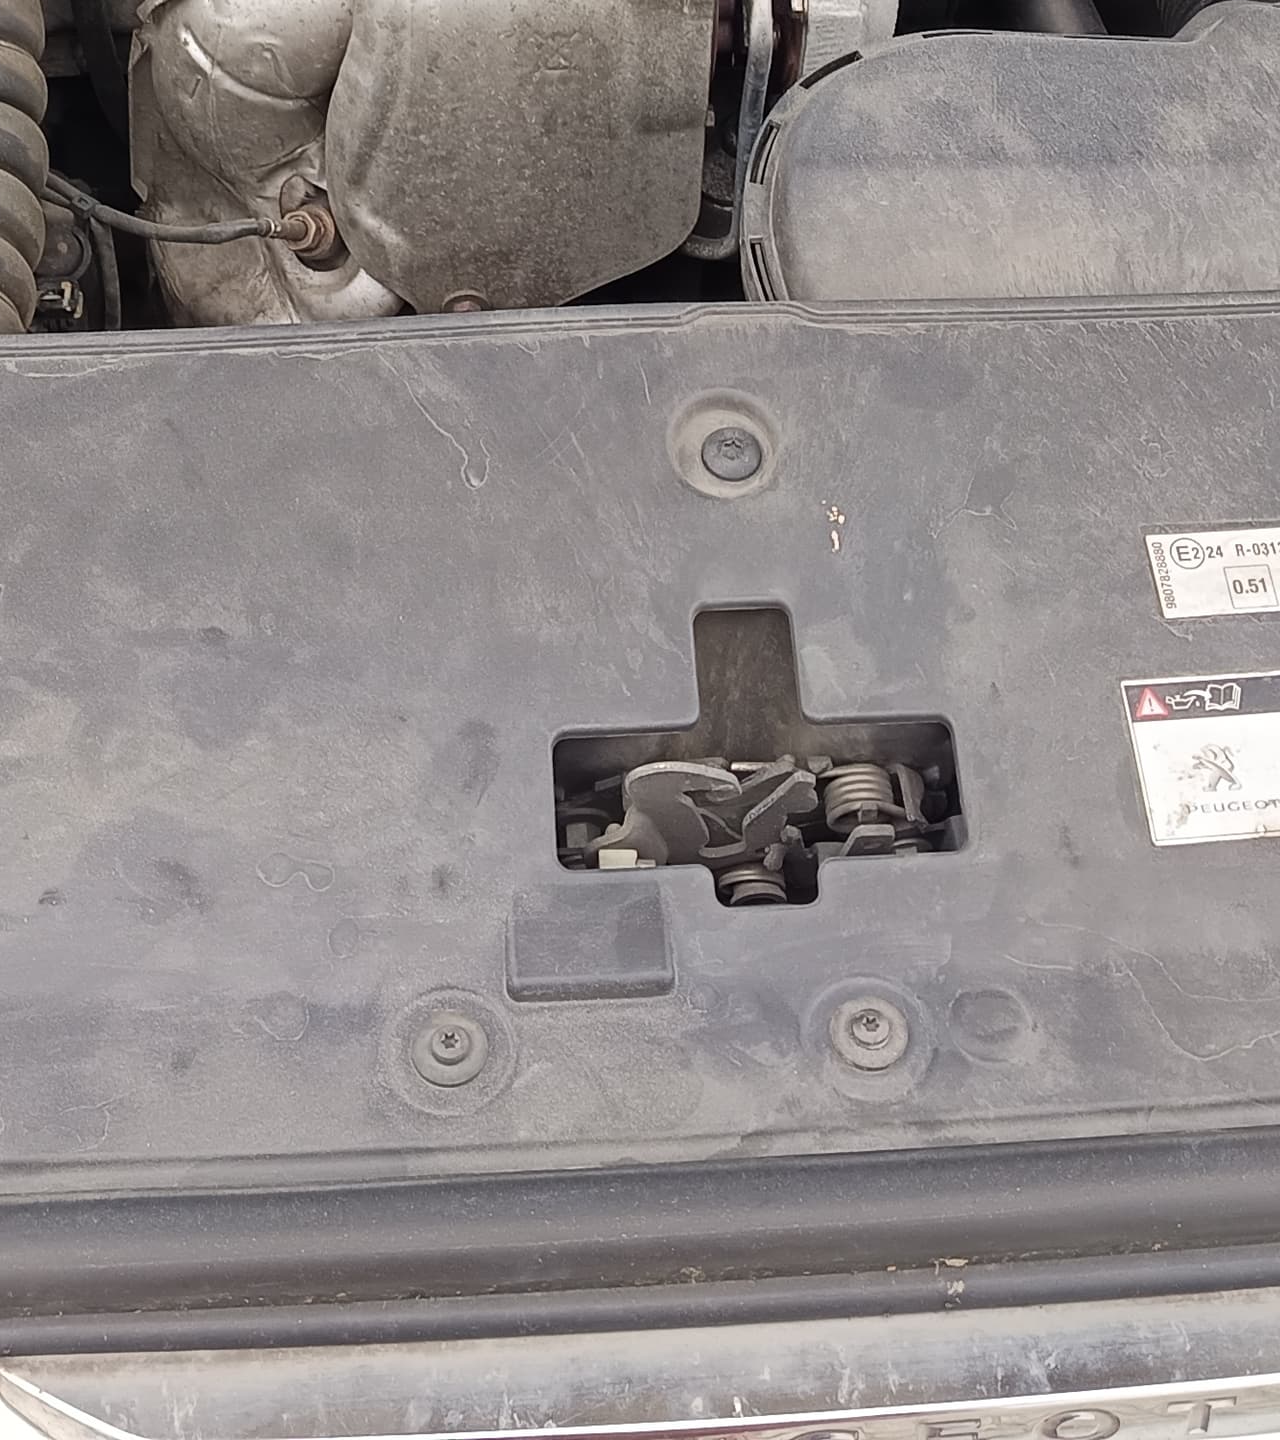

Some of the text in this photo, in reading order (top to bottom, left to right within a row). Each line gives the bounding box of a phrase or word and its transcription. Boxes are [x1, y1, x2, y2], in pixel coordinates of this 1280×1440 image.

[1206, 546, 1223, 559] 24
[1151, 541, 1177, 609] 9807828880
[1232, 578, 1269, 595] 0.51
